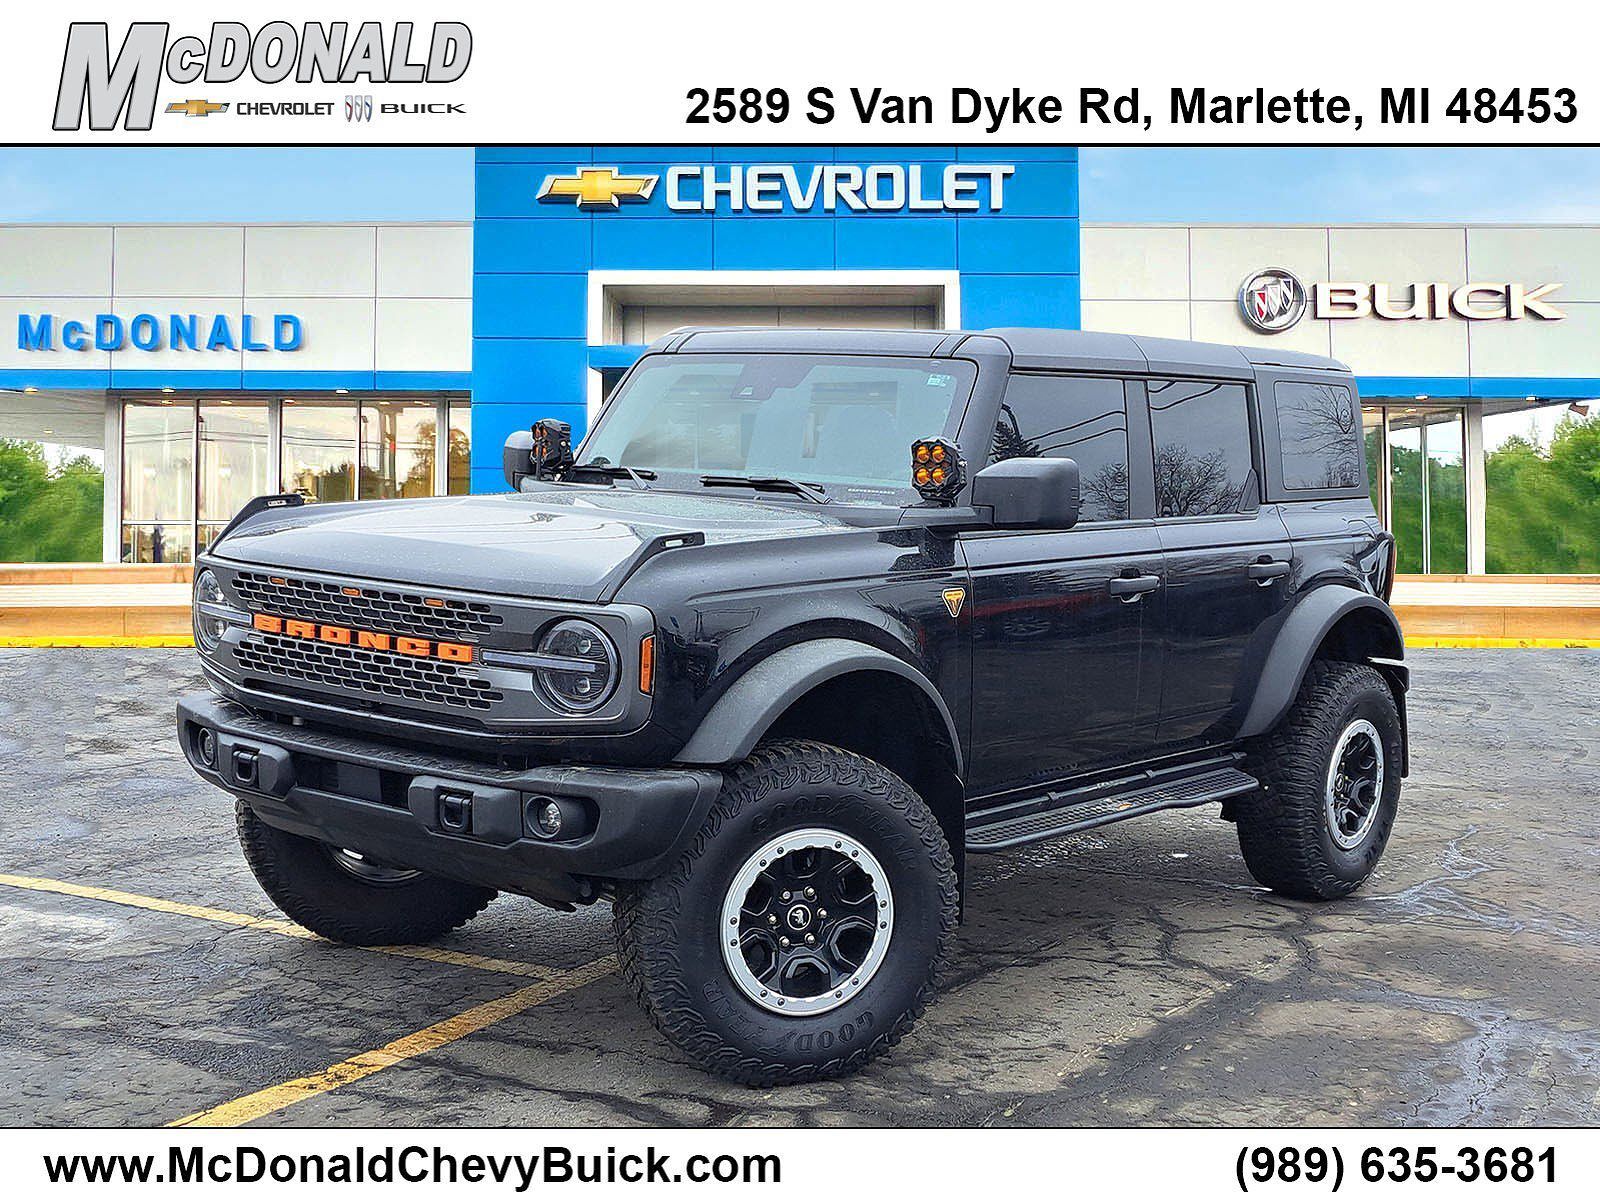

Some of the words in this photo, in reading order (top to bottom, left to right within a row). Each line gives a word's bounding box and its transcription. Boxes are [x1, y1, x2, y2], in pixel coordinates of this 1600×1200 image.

[666, 164, 1015, 212] CHEVROLET
[1314, 281, 1566, 321] BUICK
[18, 313, 304, 351] McDONALD
[253, 613, 473, 663] BRONCO
